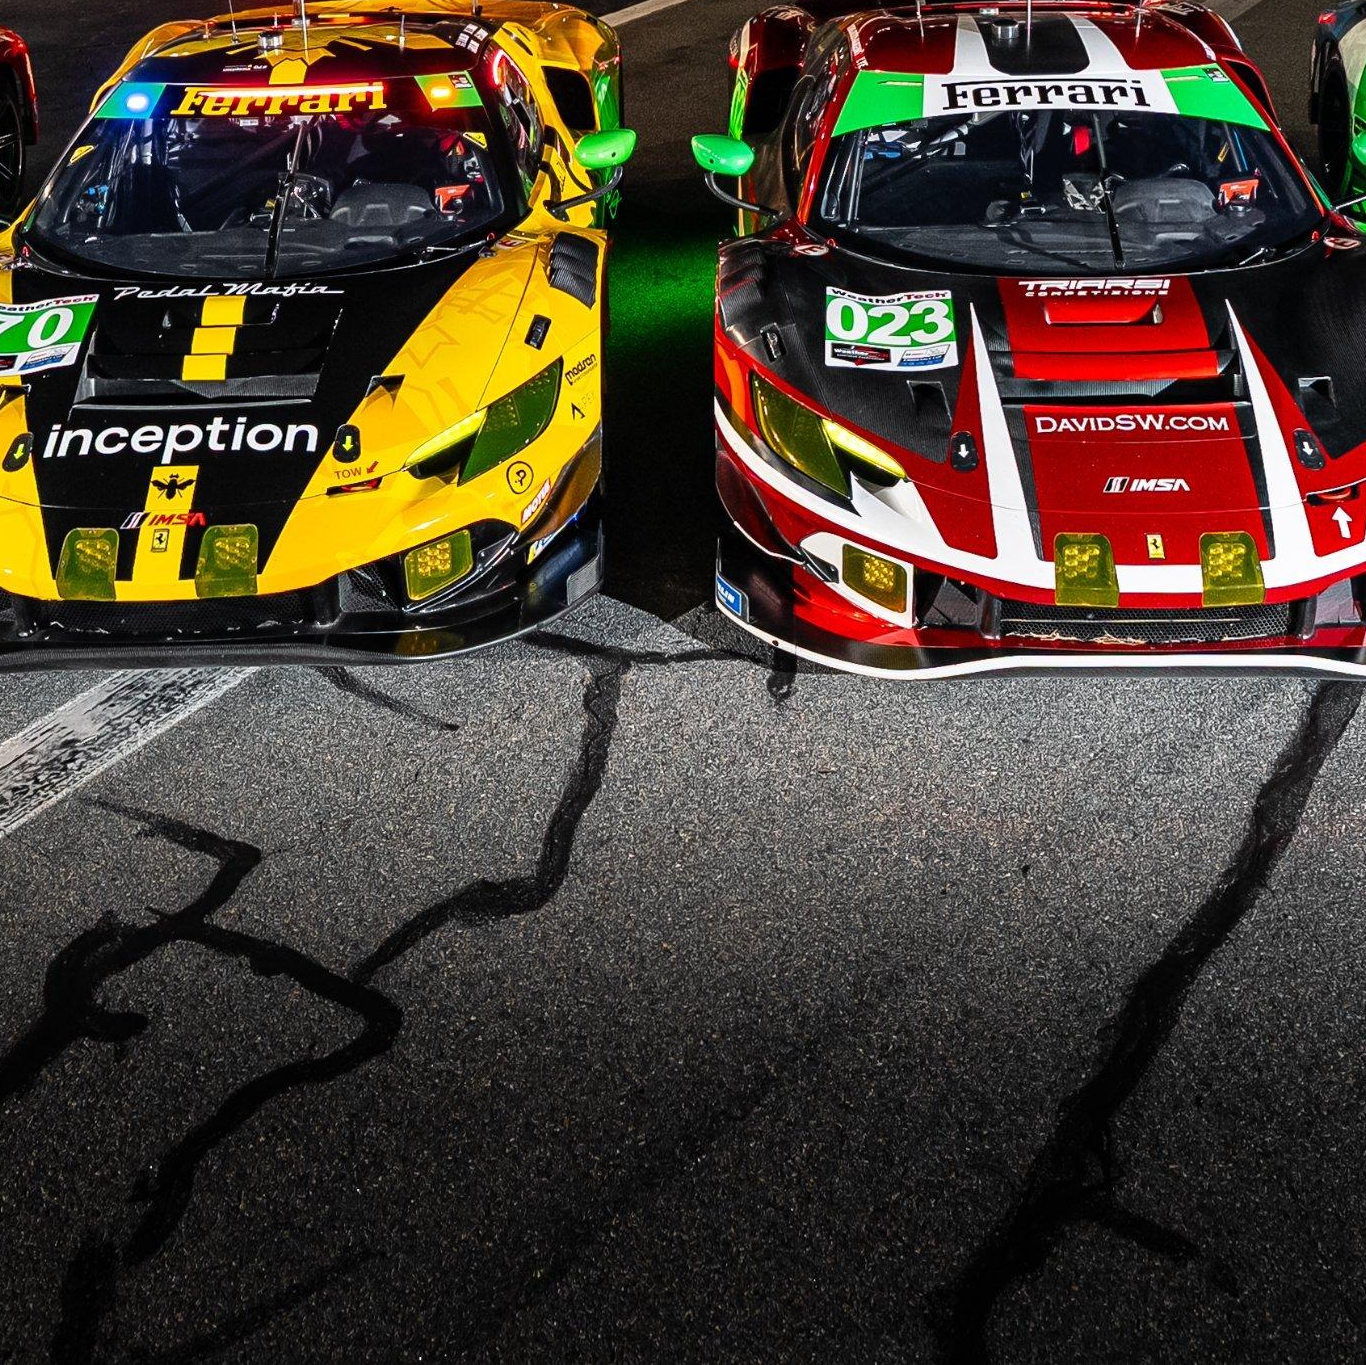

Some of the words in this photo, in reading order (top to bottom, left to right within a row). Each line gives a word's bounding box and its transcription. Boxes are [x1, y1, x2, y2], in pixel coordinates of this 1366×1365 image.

[170, 82, 388, 117] Ferrari
[941, 79, 1150, 110] Ferrari
[113, 285, 220, 301] Pedal
[223, 282, 345, 298] Mafia
[1018, 279, 1171, 290] TRIARSI
[831, 288, 948, 305] WeatherTech
[826, 297, 954, 346] 023
[43, 416, 319, 464] inception
[334, 467, 363, 480] TOW
[1130, 478, 1191, 492] IMSA
[148, 512, 207, 526] IMSA
